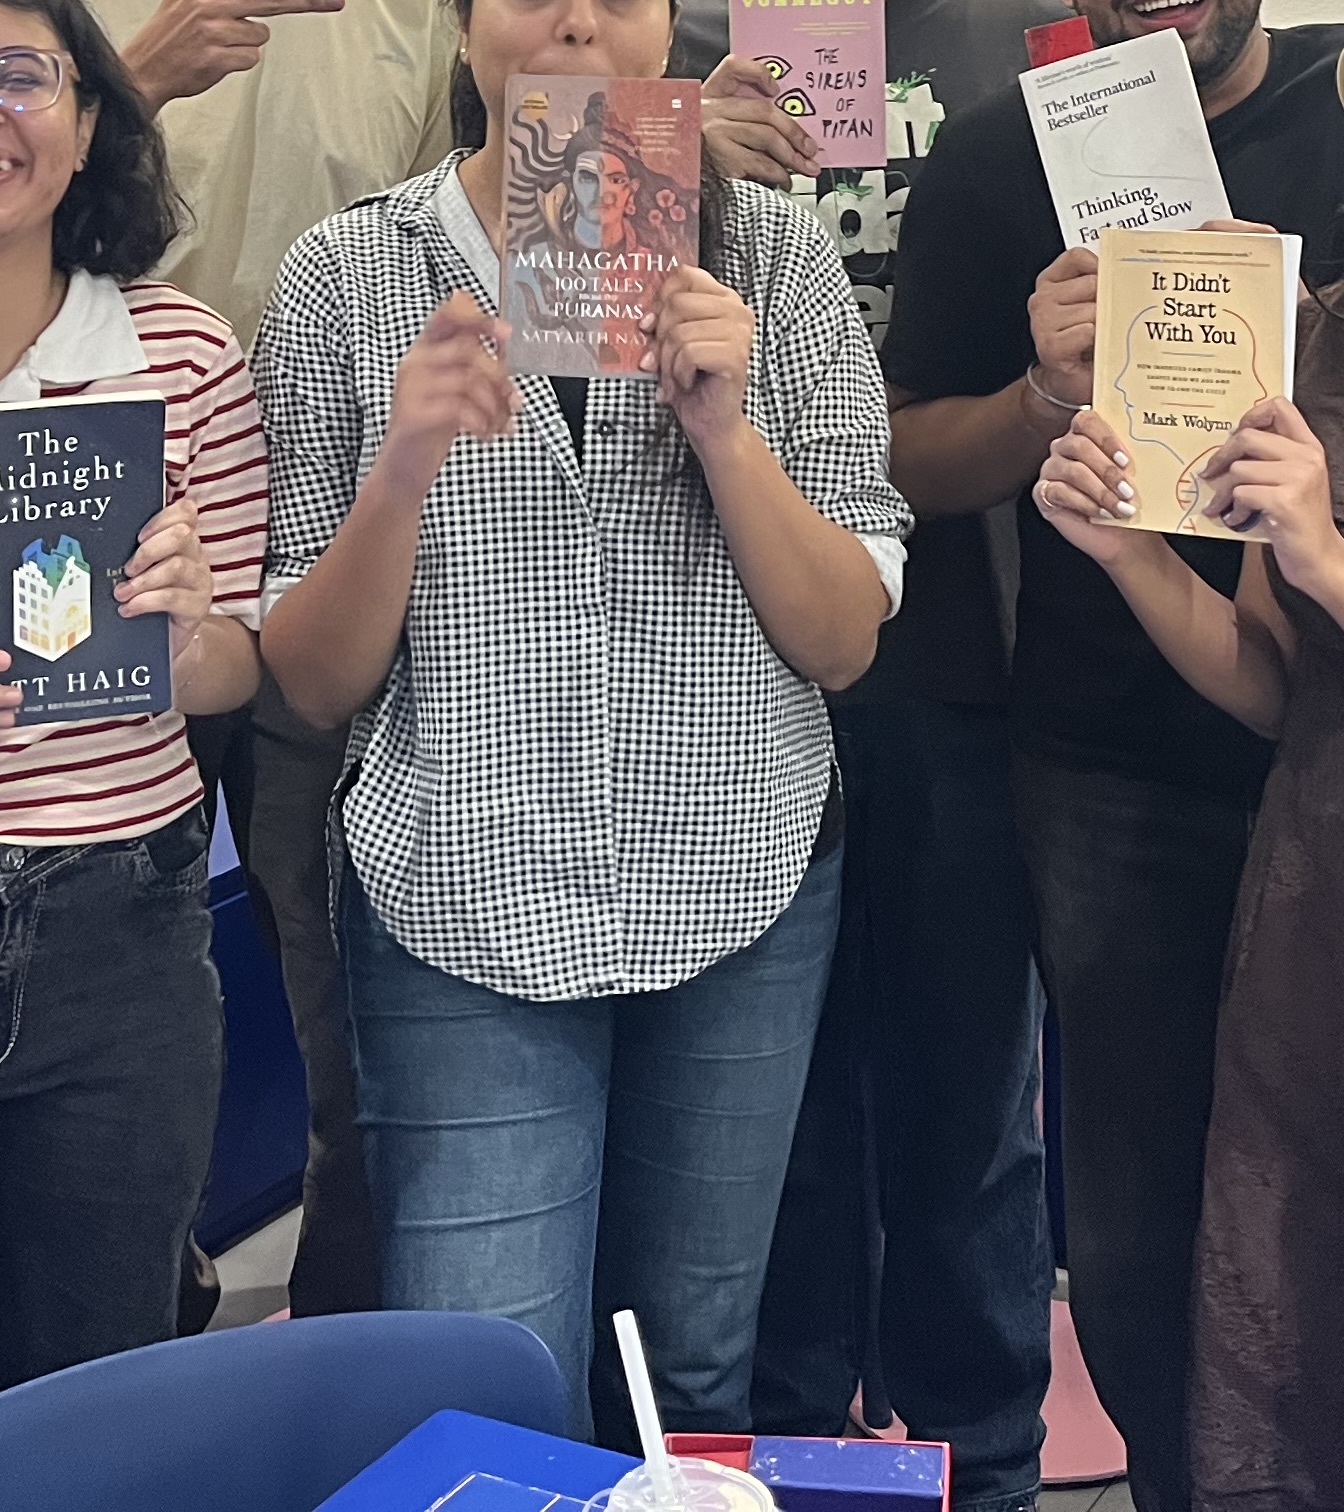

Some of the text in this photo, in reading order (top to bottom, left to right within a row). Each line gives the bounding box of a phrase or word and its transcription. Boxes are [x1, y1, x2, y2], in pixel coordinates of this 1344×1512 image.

[814, 48, 839, 65] THE
[805, 69, 867, 90] SIRENS
[1042, 100, 1069, 116] The
[1070, 69, 1157, 108] International
[836, 97, 856, 112] OF
[822, 117, 873, 139] TITAN
[1047, 104, 1109, 132] Bestseller
[1071, 186, 1159, 220] Thinking,
[1078, 200, 1193, 244] Fa and Slow
[515, 251, 679, 272] MAHAGATHA
[555, 276, 644, 294] 100 TALES
[1152, 271, 1231, 294] It Didn't
[554, 301, 644, 320] PURANAS
[1163, 297, 1217, 319] Start
[522, 329, 647, 347] SATYARTH NAY
[1144, 321, 1237, 346] With You
[1142, 412, 1179, 427] Mark
[18, 428, 79, 457] The
[67, 665, 151, 693] HAIG
